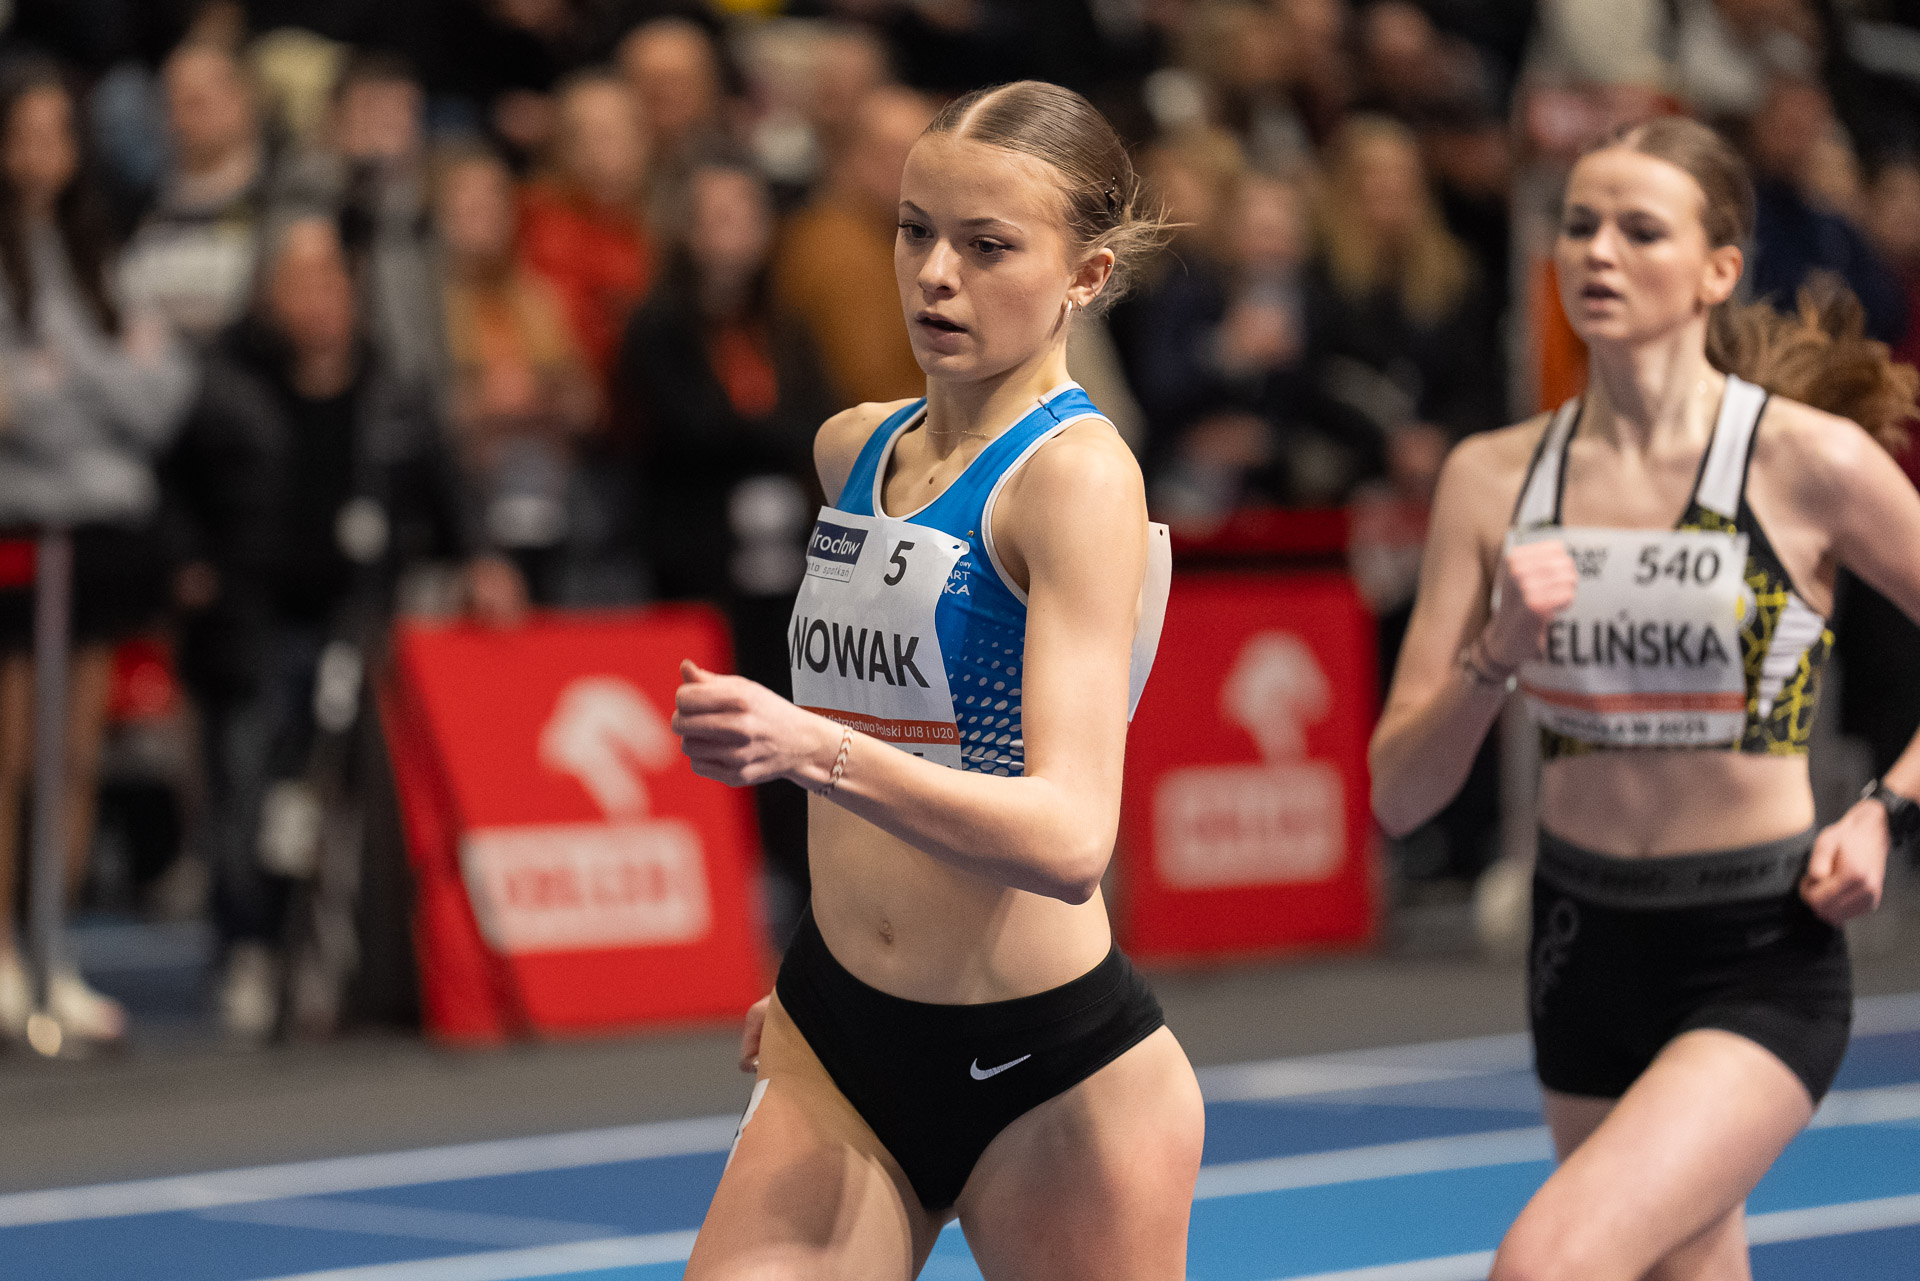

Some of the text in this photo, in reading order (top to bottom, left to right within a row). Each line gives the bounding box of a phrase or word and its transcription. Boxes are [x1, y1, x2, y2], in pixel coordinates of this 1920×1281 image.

[883, 540, 916, 586] 5
[1635, 545, 1722, 585] 540
[944, 582, 970, 596] KA
[789, 614, 931, 689] NOWAK
[1547, 609, 1730, 667] ELIŃSKA
[876, 723, 901, 737] Polski
[904, 726, 923, 738] U18
[926, 726, 930, 738] i
[932, 727, 954, 739] U20
